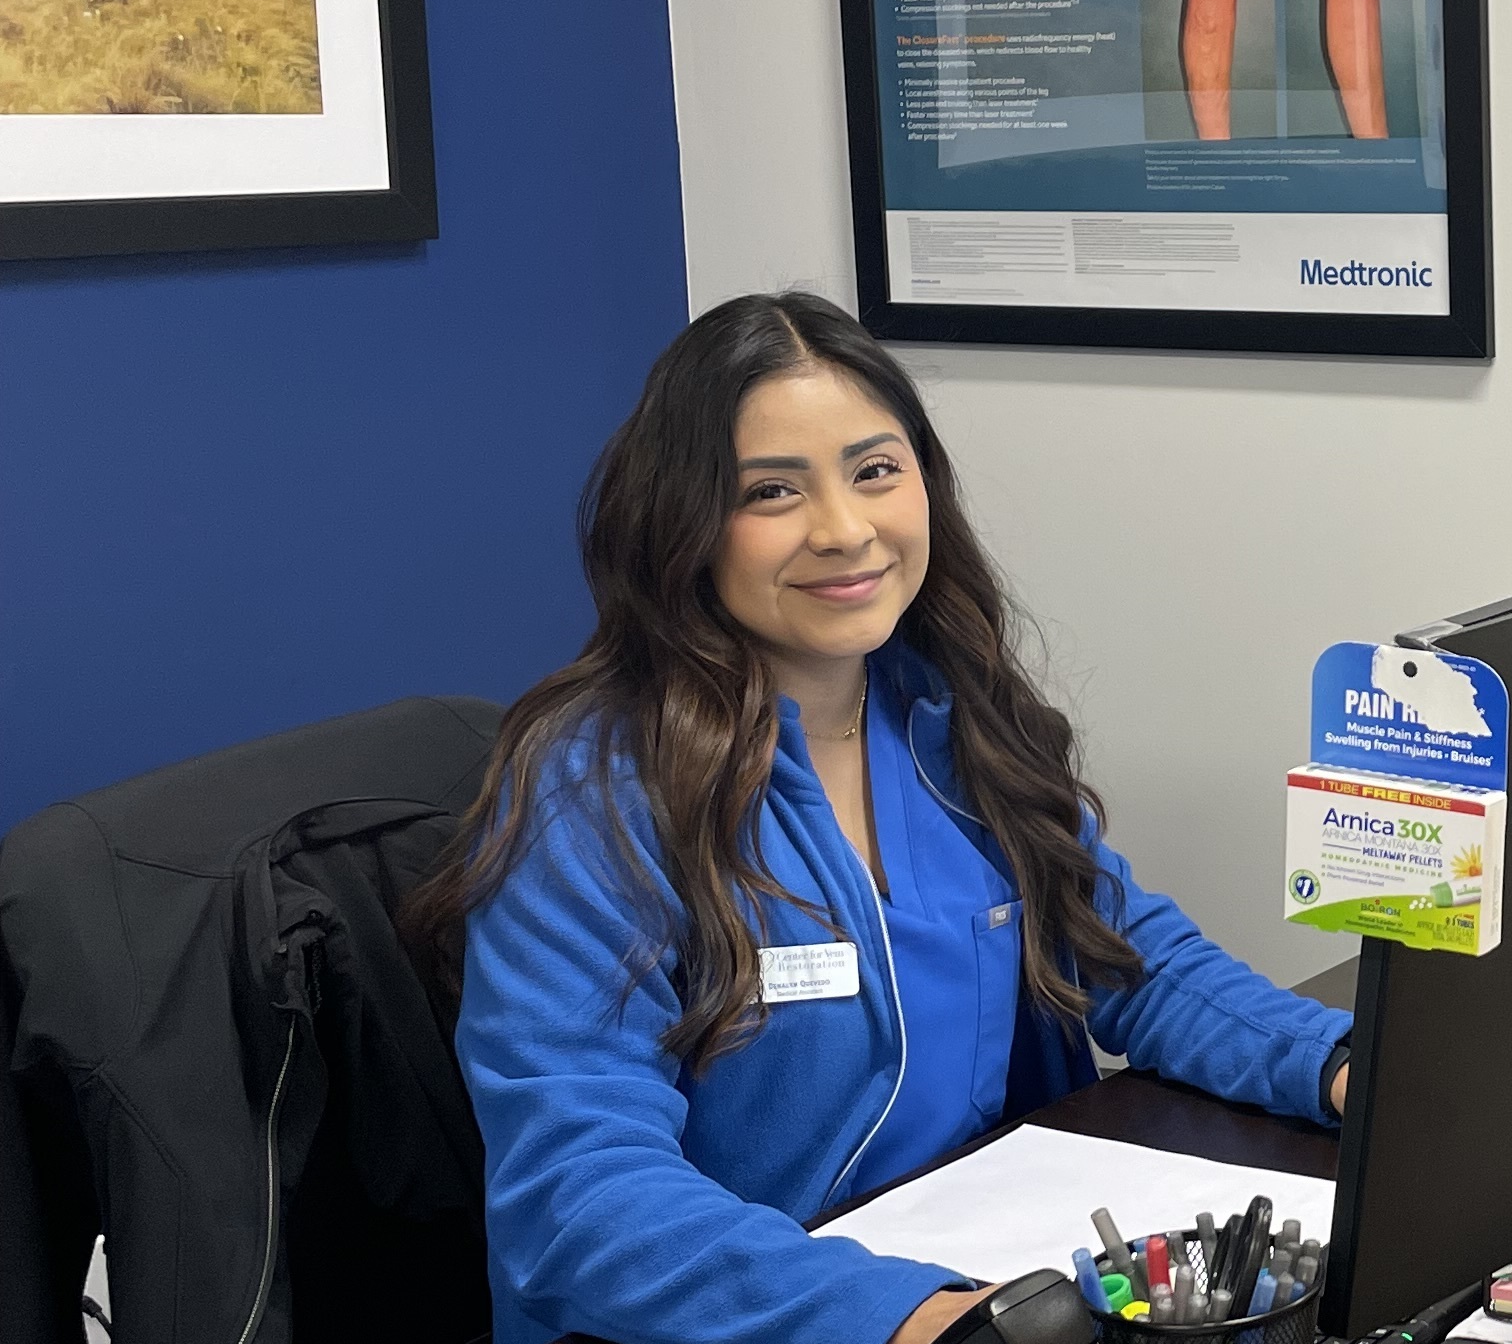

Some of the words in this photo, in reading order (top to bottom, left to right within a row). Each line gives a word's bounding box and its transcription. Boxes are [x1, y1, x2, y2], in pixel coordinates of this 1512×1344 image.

[1300, 259, 1433, 287] Medtronic
[1345, 689, 1395, 721] PAIN
[1325, 732, 1372, 751] Swelling
[1373, 739, 1400, 753] from
[1402, 743, 1443, 759] Injuries
[1346, 721, 1386, 737] Muscle
[1388, 727, 1411, 741] Pain
[1414, 731, 1421, 742] &
[1423, 733, 1473, 750] Stiffness
[1320, 780, 1325, 790] 1
[1328, 781, 1359, 796] TUBE
[1362, 786, 1411, 803] FREE
[1413, 794, 1452, 810] INSIDE
[1322, 808, 1394, 836] Arnica
[1397, 819, 1443, 844] 30X
[1322, 827, 1362, 844] ARNICA
[1364, 833, 1419, 853] MONTANA
[1421, 842, 1443, 855] 30X
[1320, 852, 1390, 871] HOMEOPATHIC
[1394, 863, 1443, 878] MEDICINE
[1362, 847, 1407, 863] MELTAWAY
[1409, 854, 1443, 868] PELLETS
[778, 960, 845, 973] Restoration
